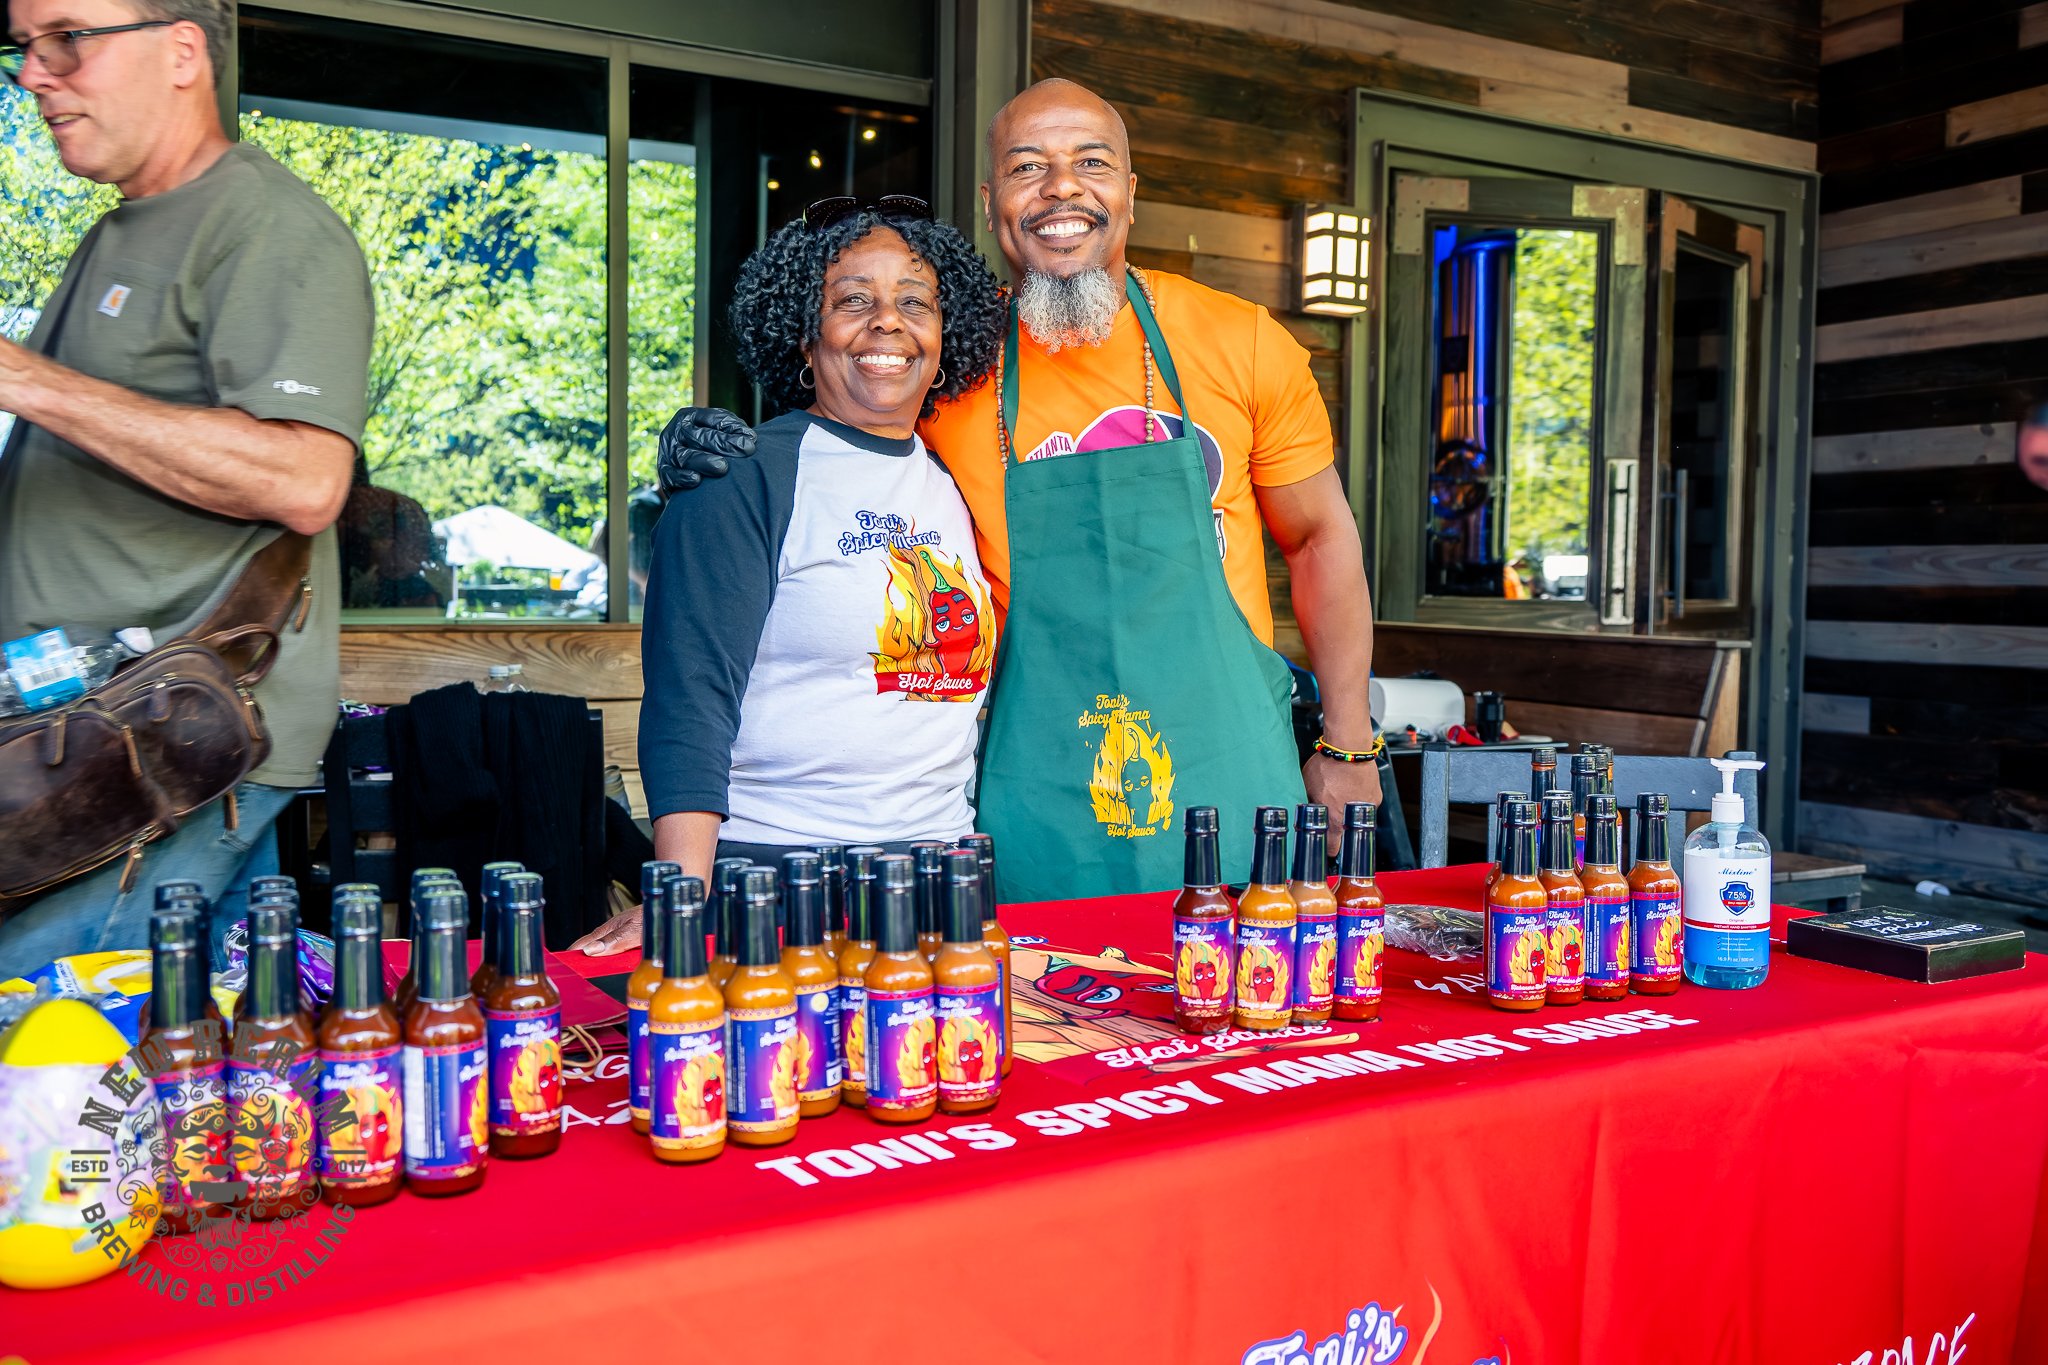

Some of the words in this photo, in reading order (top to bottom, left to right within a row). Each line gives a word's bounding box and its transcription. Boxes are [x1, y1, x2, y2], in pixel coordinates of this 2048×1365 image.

[855, 510, 908, 532] Toni's
[838, 532, 889, 556] Spicy
[889, 530, 941, 550] Mama
[898, 674, 934, 690] Hot
[934, 674, 974, 691] Sauce
[1096, 694, 1130, 710] Toni's
[1078, 709, 1111, 729] Spicy
[1111, 708, 1150, 726] Mama
[1107, 824, 1127, 837] Hot
[1126, 824, 1156, 839] Sauce
[1728, 891, 1747, 899] 75%
[1503, 923, 1525, 935] Spicy
[1546, 919, 1559, 929] icy
[1872, 920, 1930, 934] spice
[1174, 932, 1188, 944] icy
[1237, 936, 1250, 947] icy
[1095, 1038, 1199, 1067] Hot
[1201, 1024, 1332, 1051] Sauce
[755, 1123, 1017, 1187] TONI'S
[1015, 1080, 1224, 1137] SPICY
[1211, 1049, 1425, 1095] MAMA
[1396, 1034, 1532, 1063] HOT
[1512, 1008, 1700, 1045] SAUCE
[1242, 1302, 1408, 1365] Tni's
